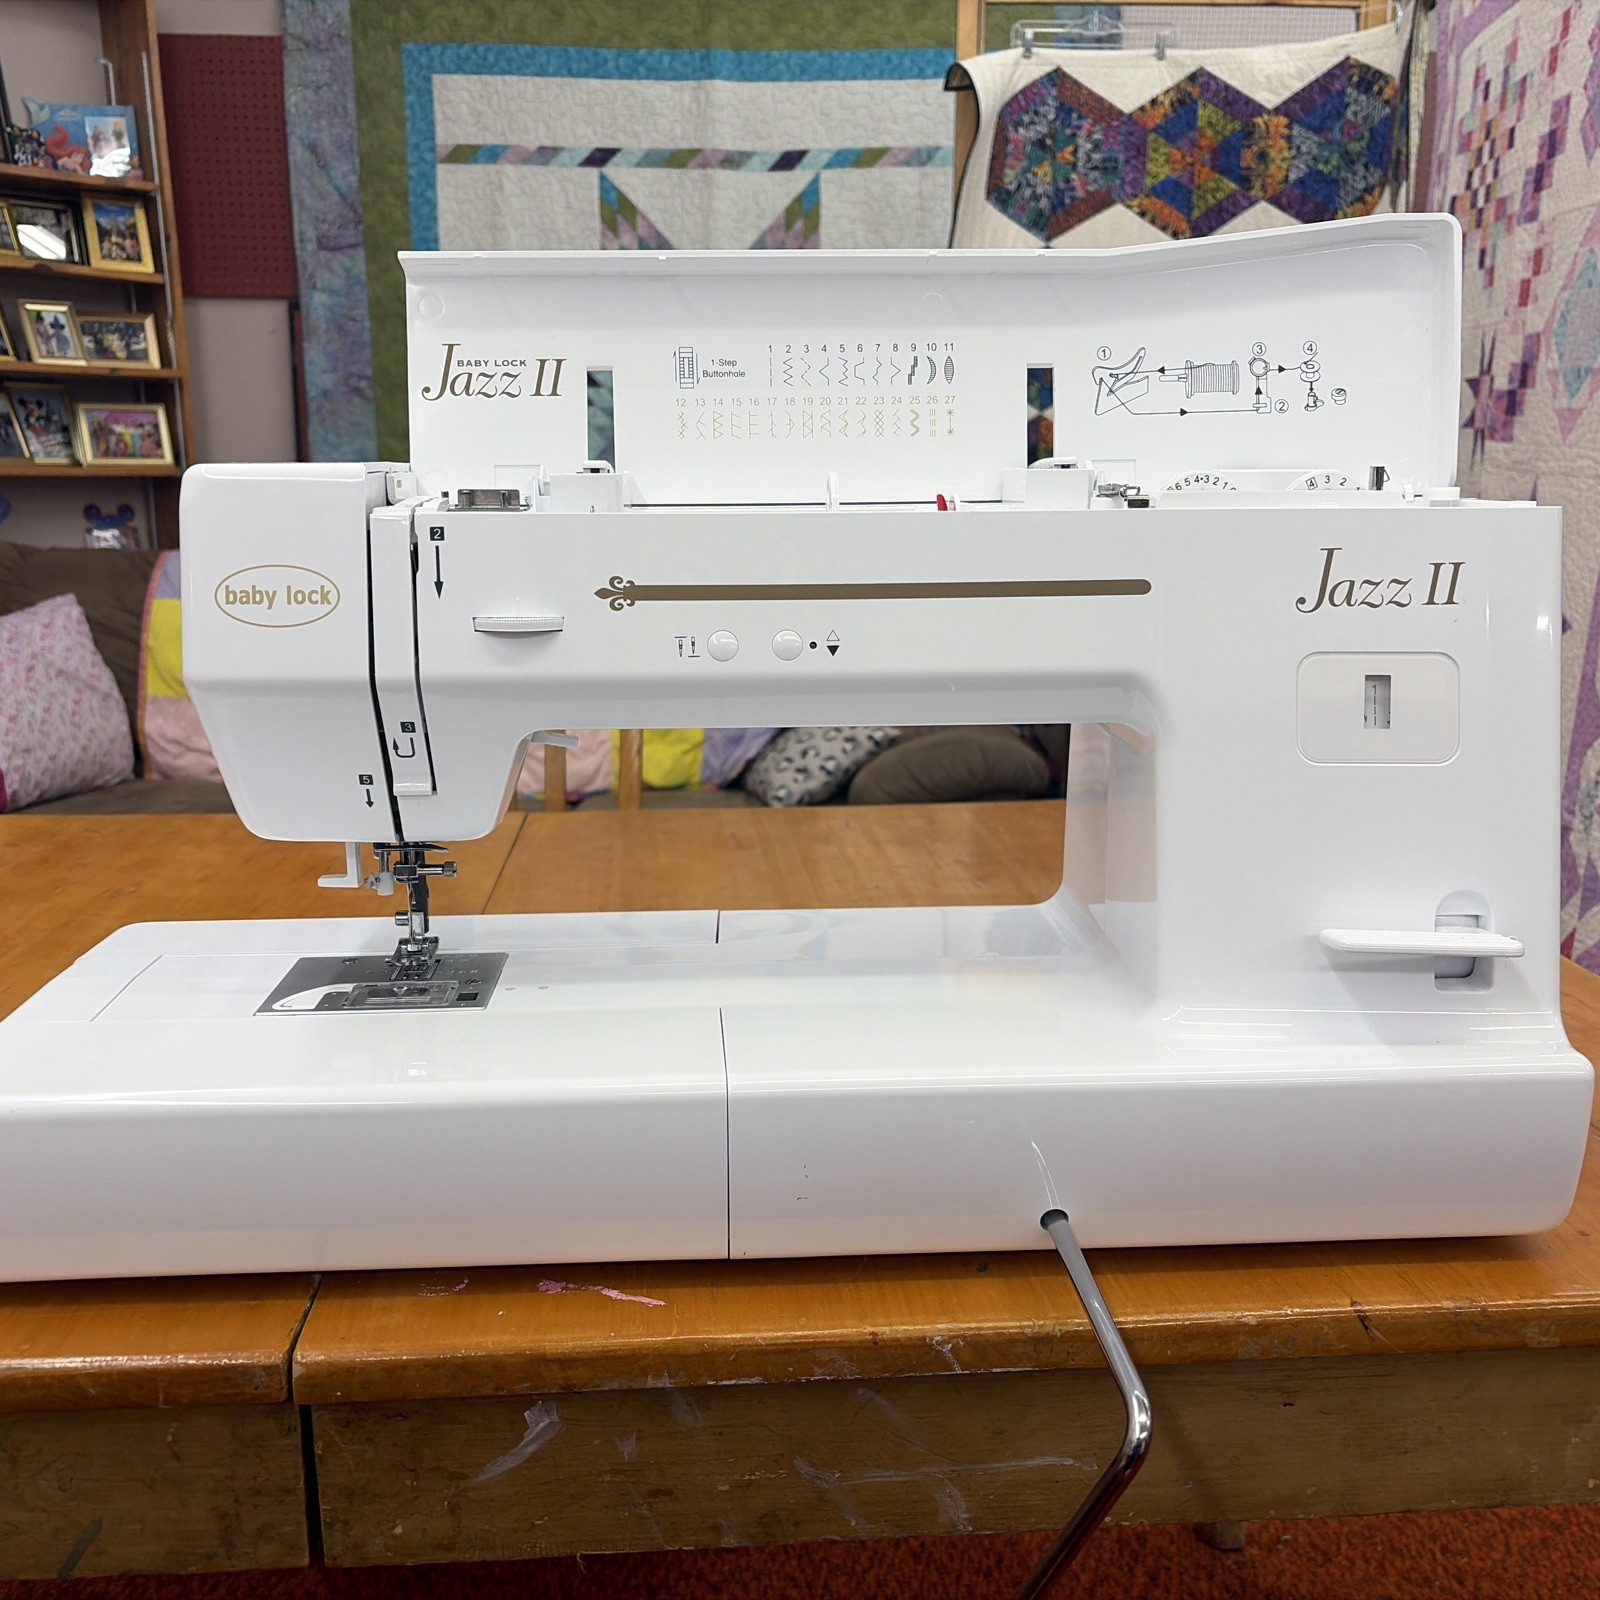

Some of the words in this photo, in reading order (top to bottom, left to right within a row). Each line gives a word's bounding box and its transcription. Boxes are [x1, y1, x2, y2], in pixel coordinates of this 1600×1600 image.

[785, 345, 792, 353] 2
[803, 345, 810, 353] 3
[820, 344, 828, 353] 4
[839, 344, 846, 353] 5
[857, 344, 864, 352] 6
[875, 344, 881, 352] 7
[892, 343, 899, 352] 8
[910, 343, 917, 352] 9
[926, 343, 938, 352] 10
[944, 343, 954, 352] 11
[457, 359, 489, 367] BABY
[494, 359, 527, 367] LOCK
[710, 358, 738, 368] 1-Step
[421, 343, 522, 402] Jazz
[529, 358, 567, 397] II
[702, 369, 746, 378] Buttonhole
[676, 398, 686, 406] 12
[695, 398, 706, 406] 13
[713, 398, 724, 406] 14
[731, 398, 742, 406] 15
[749, 398, 760, 406] 16
[767, 398, 777, 406] 17
[785, 397, 796, 406] 18
[803, 397, 813, 405] 19
[820, 397, 831, 405] 20
[838, 397, 848, 405] 21
[856, 397, 867, 405] 22
[873, 396, 885, 405] 23
[891, 396, 902, 405] 24
[909, 396, 921, 404] 25
[927, 396, 939, 404] 26
[945, 396, 956, 404] 27
[1184, 477, 1191, 486] 5
[1212, 477, 1220, 485] 2
[1324, 475, 1331, 484] 3
[1340, 477, 1347, 486] 2
[432, 528, 443, 540] 2
[1295, 547, 1413, 614] Jazz
[1421, 561, 1466, 606] II
[224, 585, 278, 610] baby
[286, 585, 332, 606] lock
